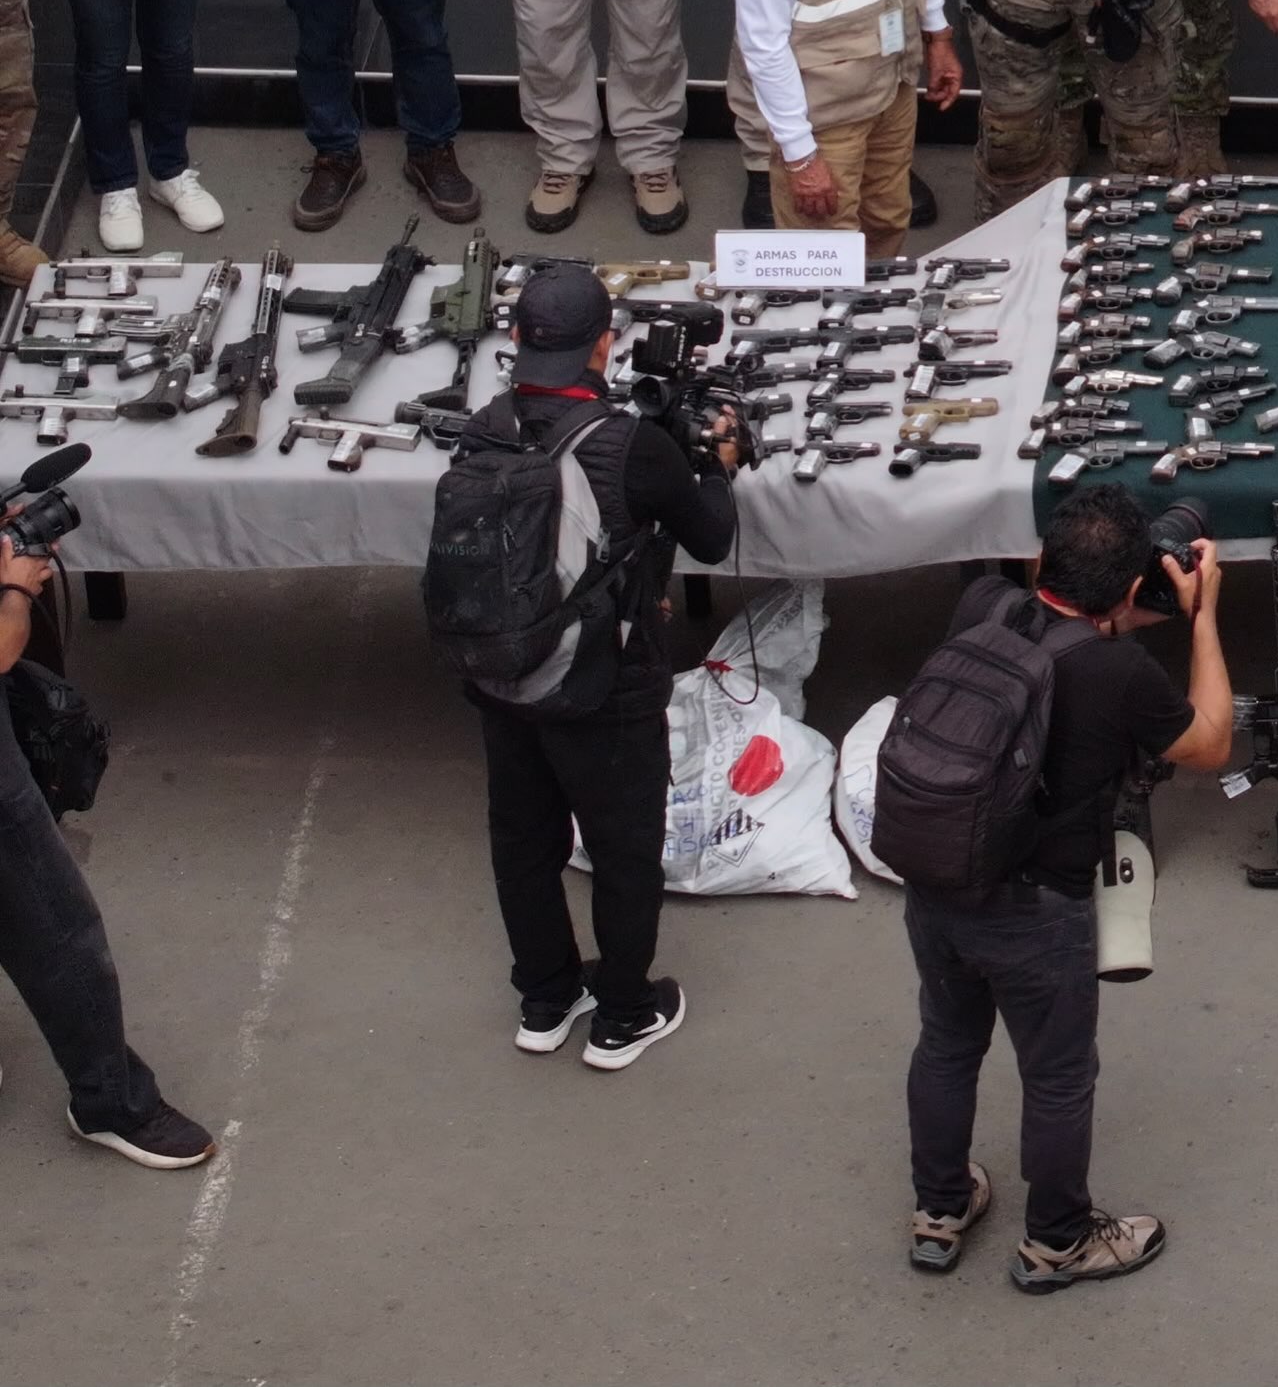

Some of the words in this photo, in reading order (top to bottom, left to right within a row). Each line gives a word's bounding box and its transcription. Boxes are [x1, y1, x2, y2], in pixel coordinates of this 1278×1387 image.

[754, 248, 798, 261] ARMAS
[806, 248, 838, 260] PARA
[755, 266, 843, 278] DESTRUCCION
